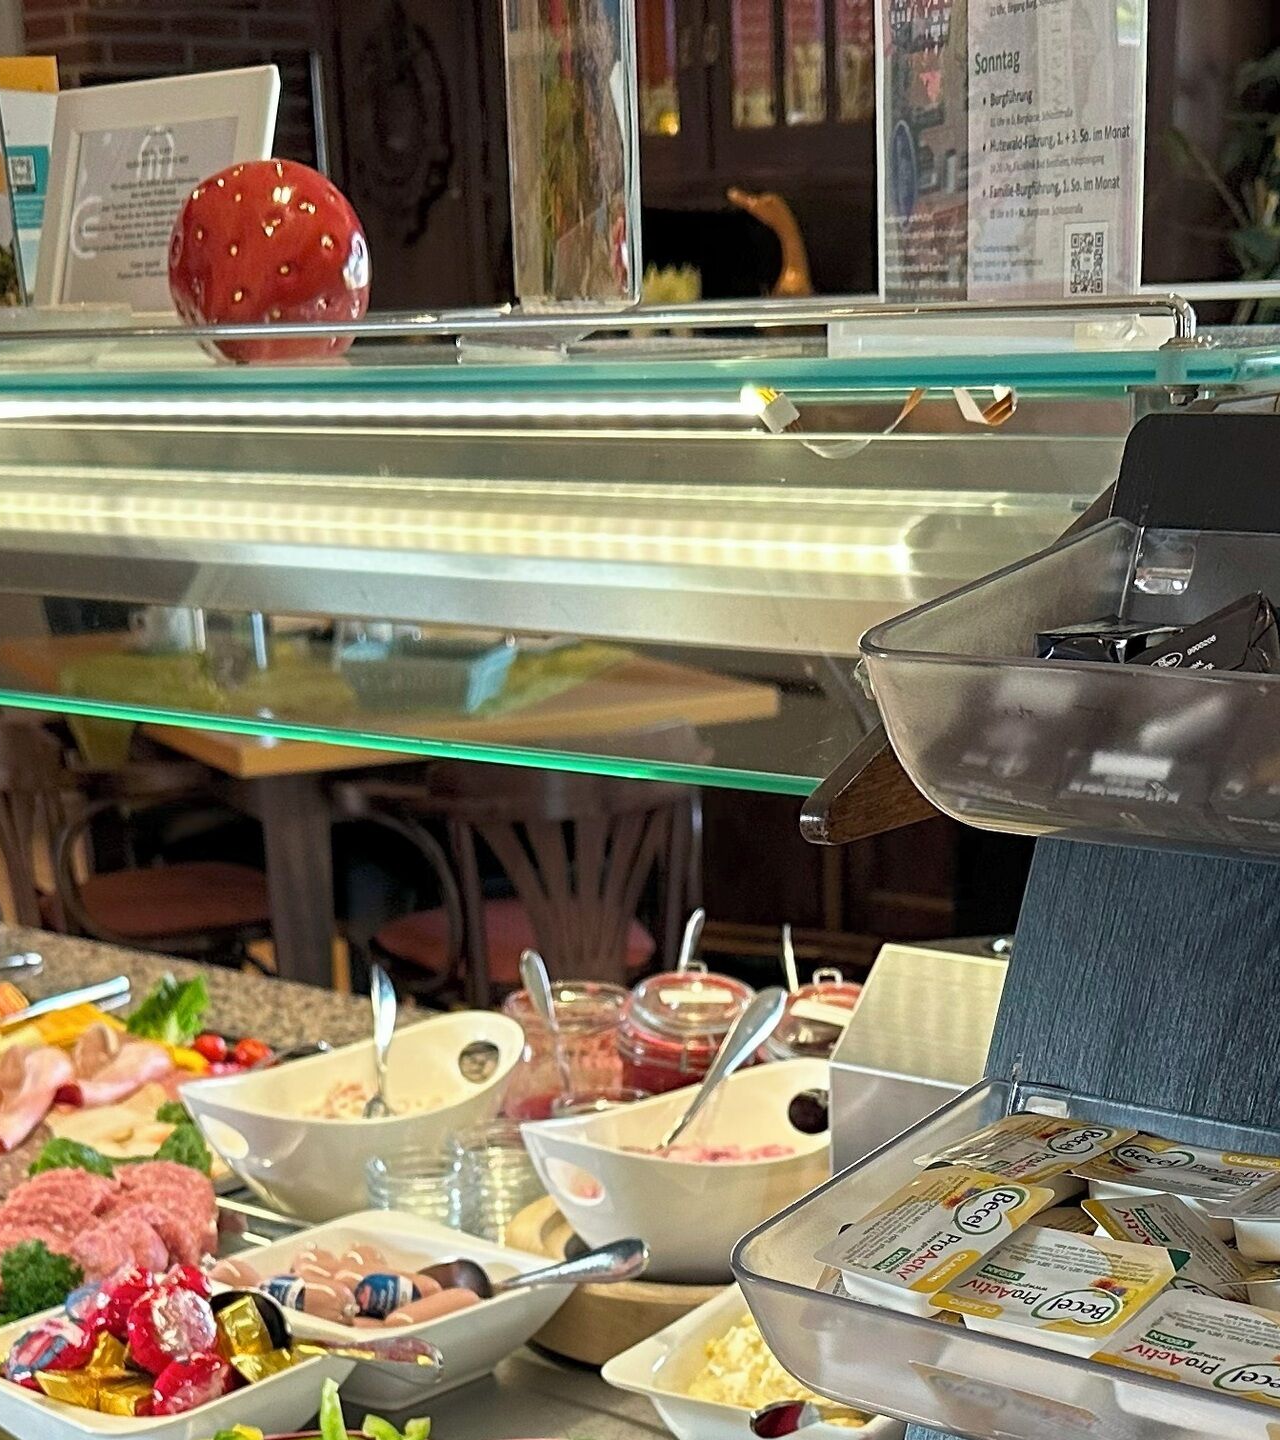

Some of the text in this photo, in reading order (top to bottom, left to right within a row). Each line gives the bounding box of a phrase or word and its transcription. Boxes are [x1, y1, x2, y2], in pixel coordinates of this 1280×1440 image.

[975, 51, 1020, 75] Sonntag
[990, 89, 1033, 108] Burgführung
[1080, 127, 1091, 143] So.
[1093, 126, 1103, 141] im
[1104, 124, 1131, 140] Monat
[989, 175, 1120, 199] Familie-Burgführung, 1. So. im Monat
[1121, 1146, 1183, 1168] Becel
[964, 1192, 1013, 1229] Becel
[895, 1233, 963, 1282] ProActiv
[983, 1265, 1022, 1281] VEGAN
[959, 1279, 1043, 1307] ProActiv
[1047, 1298, 1113, 1323] Becel
[1149, 1331, 1195, 1349] VEGAN
[1128, 1343, 1222, 1376] ProActiv
